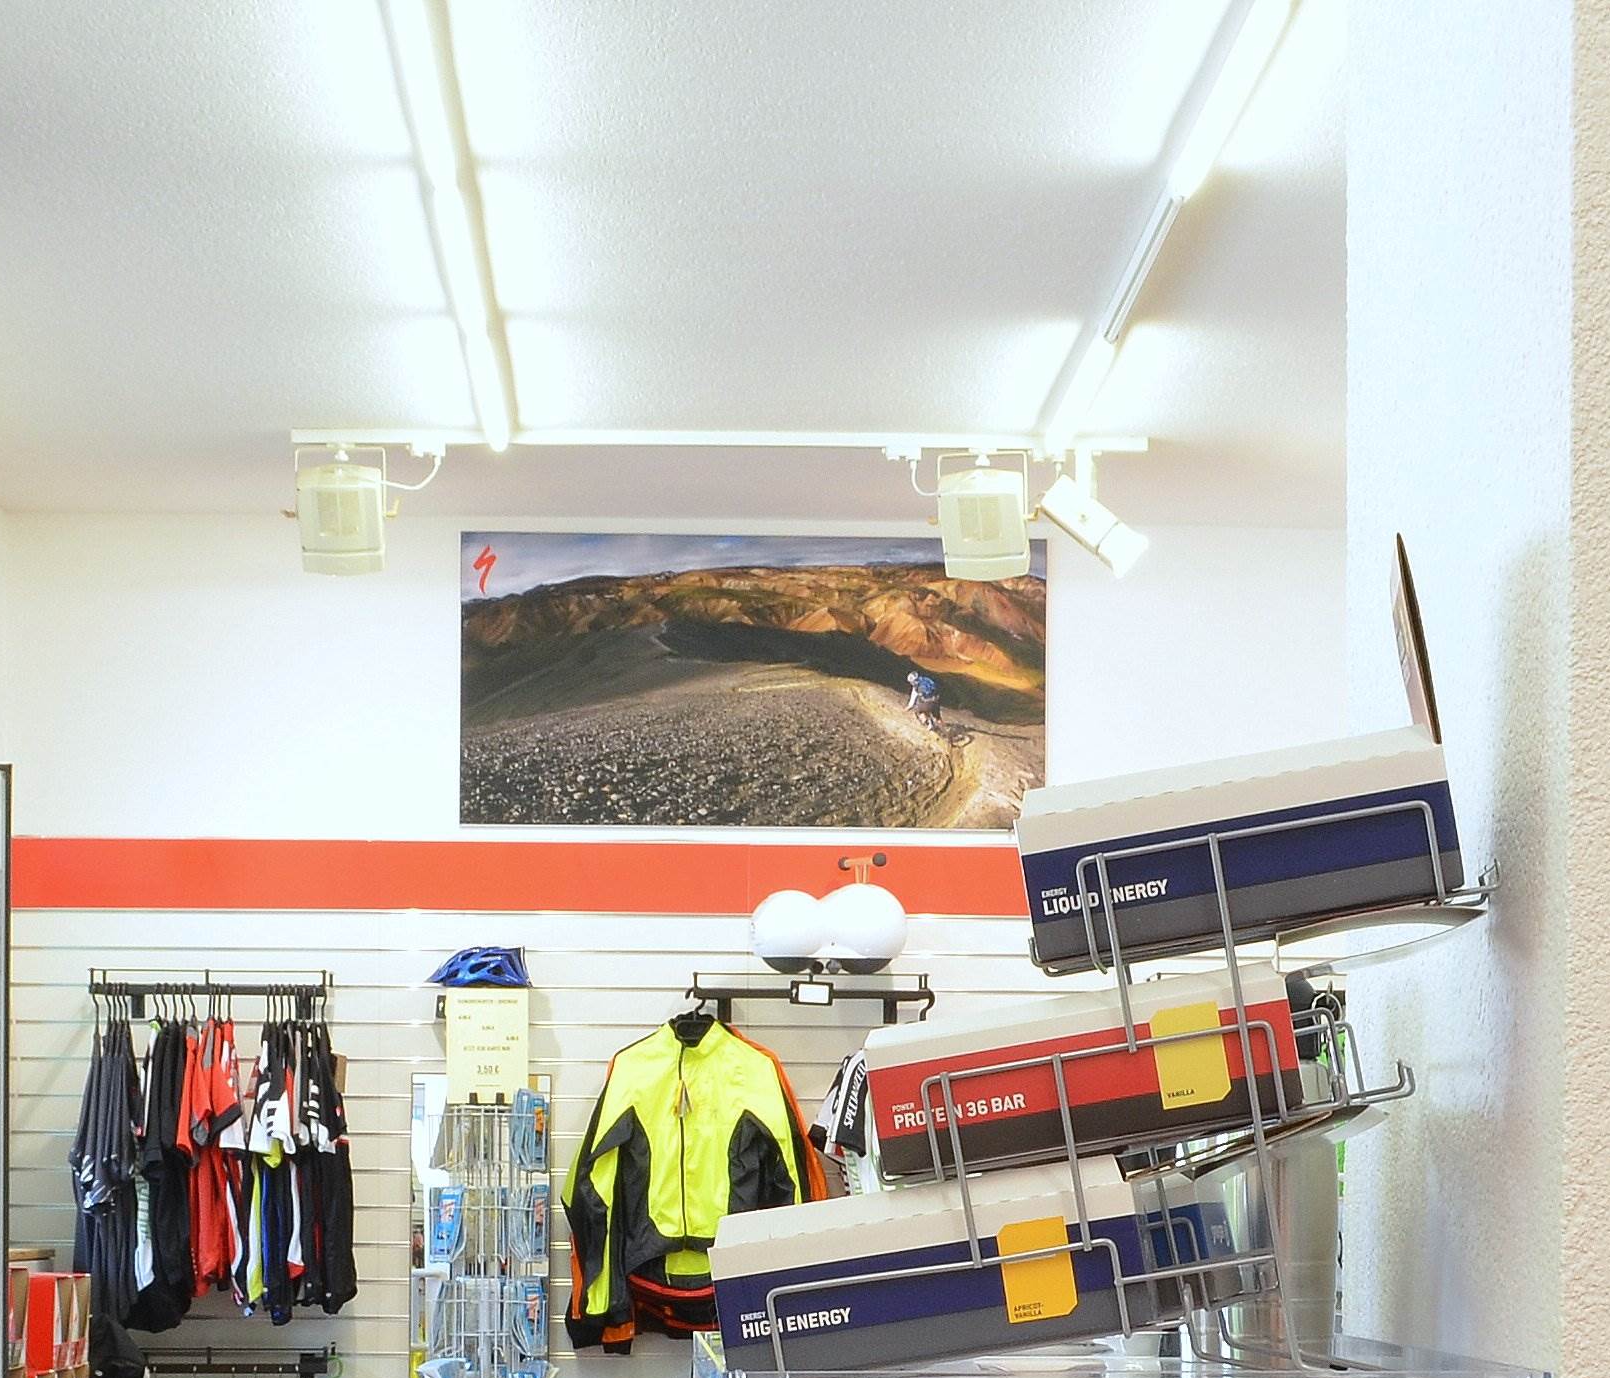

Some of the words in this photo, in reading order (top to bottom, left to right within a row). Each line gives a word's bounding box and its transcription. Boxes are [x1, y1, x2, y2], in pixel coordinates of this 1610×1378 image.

[1042, 892, 1100, 916] LIQUD
[1109, 878, 1168, 904] NERGY
[894, 1106, 963, 1130] PROEN
[966, 1100, 987, 1117] 36
[991, 1093, 1027, 1113] BAR
[787, 1307, 851, 1332] ENERGY
